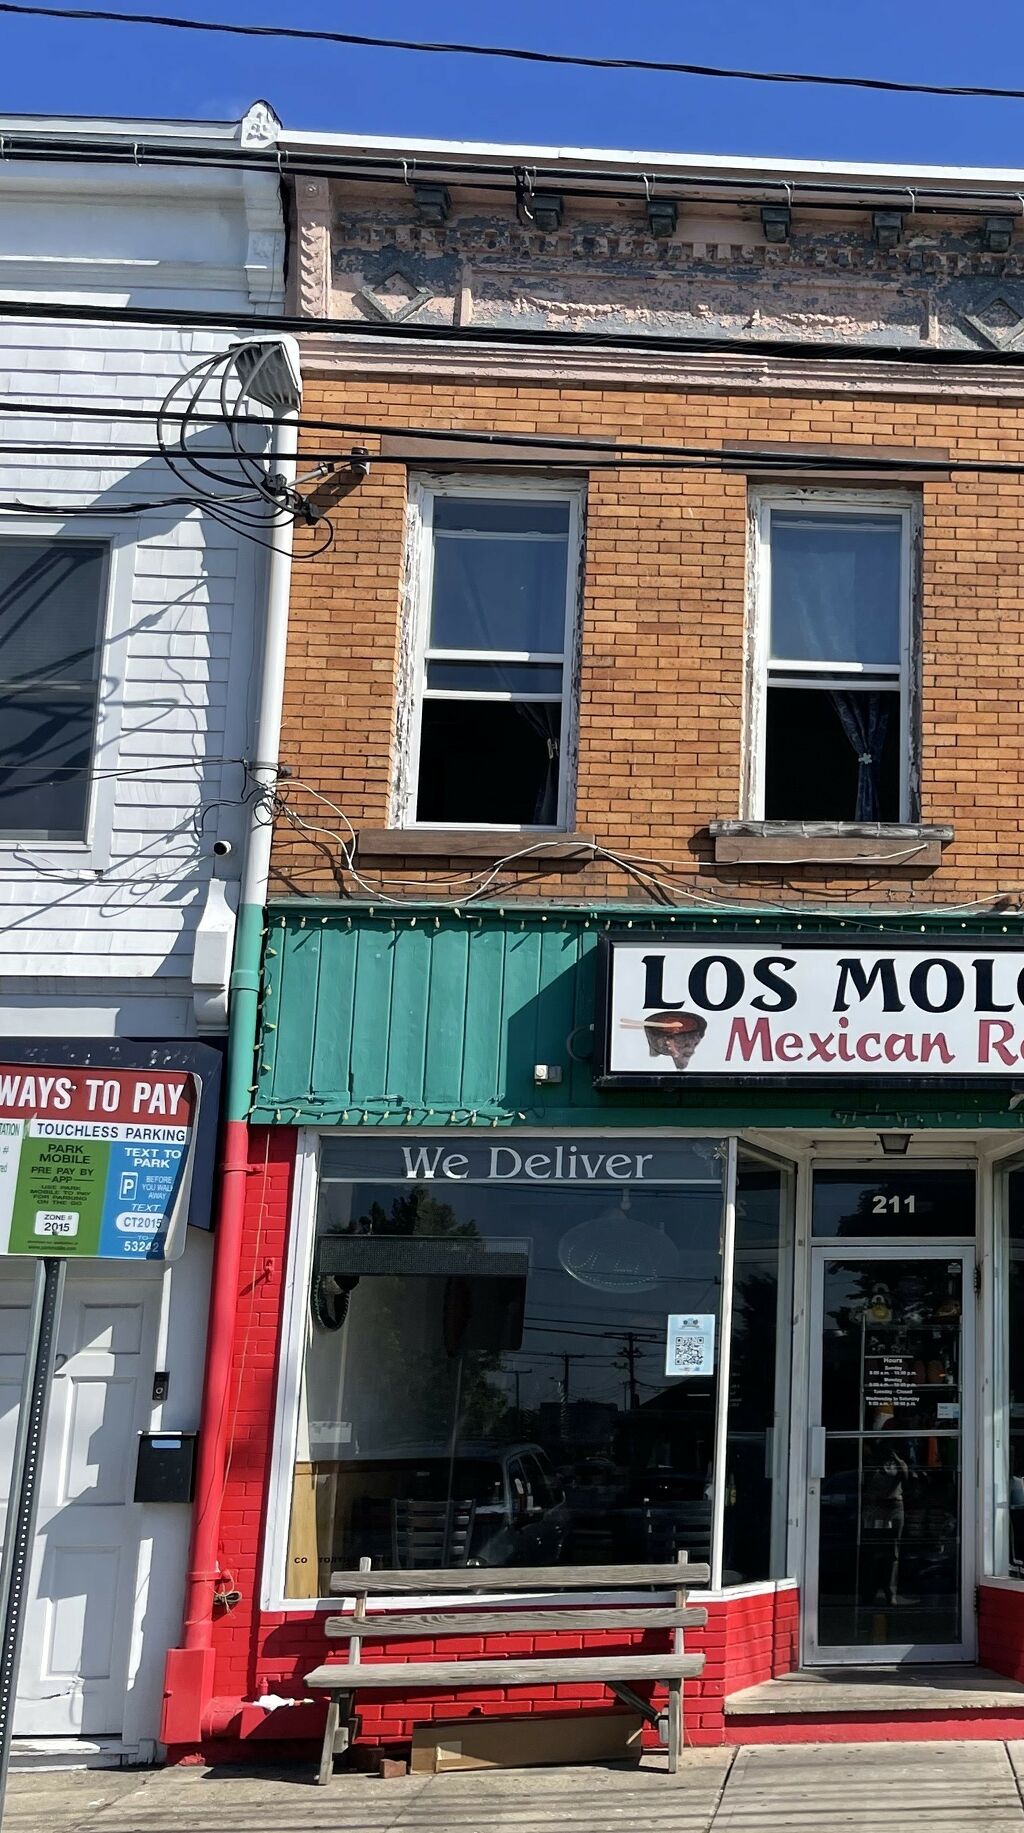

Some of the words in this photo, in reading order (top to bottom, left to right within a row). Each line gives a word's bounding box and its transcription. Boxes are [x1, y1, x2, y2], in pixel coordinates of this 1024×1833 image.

[641, 955, 799, 1012] LOS
[725, 1016, 956, 1066] Mexican
[0, 1075, 72, 1110] WAYS
[85, 1079, 121, 1112] TO
[132, 1082, 185, 1116] PAY
[37, 1122, 119, 1139] TOUCHLESS
[125, 1127, 185, 1142] PARKING
[48, 1144, 84, 1154] PARK
[124, 1147, 159, 1158] TEXT
[164, 1149, 182, 1159] TO
[39, 1153, 91, 1164] MOBILE
[134, 1158, 170, 1168] PARK
[401, 1147, 470, 1179] We
[488, 1145, 654, 1179] Deliver
[31, 1166, 52, 1174] PRE
[57, 1167, 76, 1175] PAY
[80, 1168, 94, 1176] BY
[146, 1175, 173, 1184] BEFORE
[131, 1203, 161, 1212] TEXT
[872, 1195, 915, 1214] 211
[44, 1222, 71, 1232] 2015
[123, 1217, 163, 1229] CT2015
